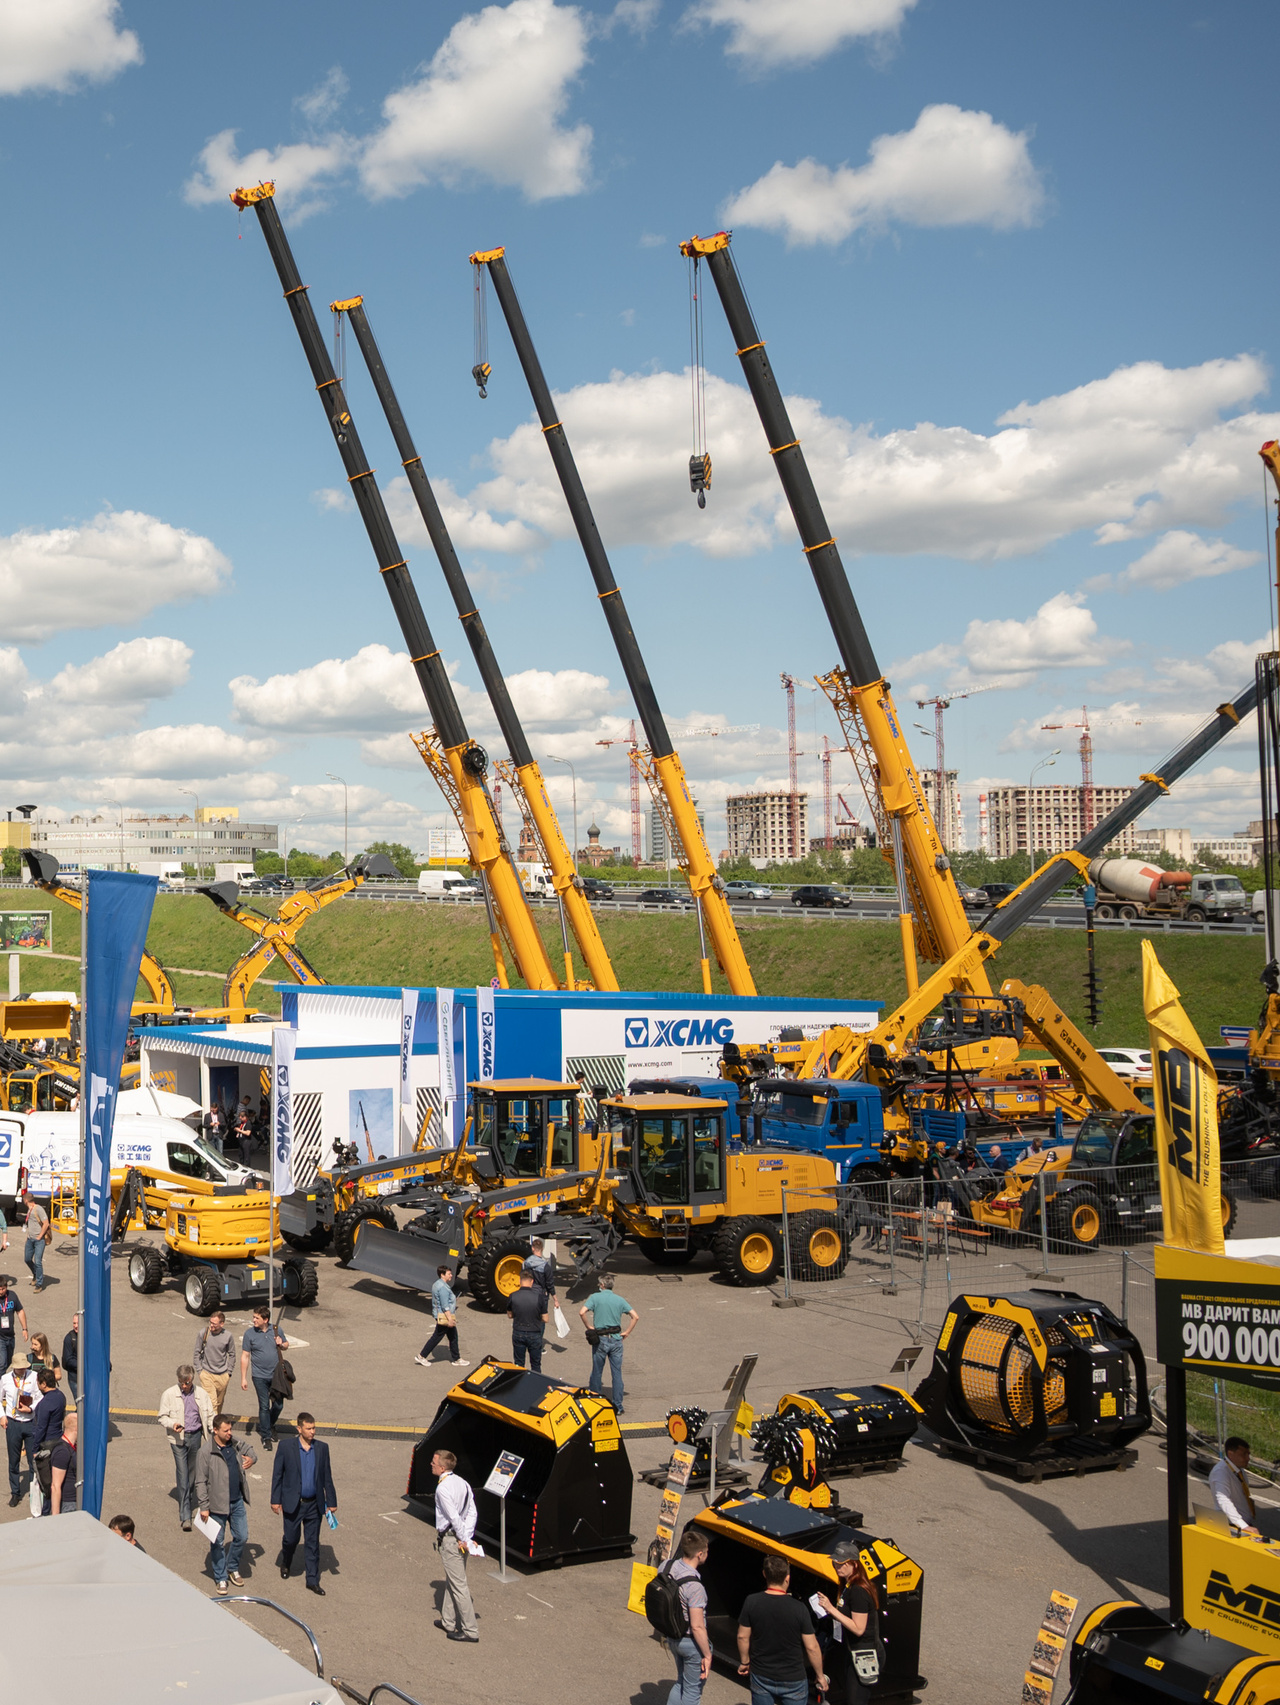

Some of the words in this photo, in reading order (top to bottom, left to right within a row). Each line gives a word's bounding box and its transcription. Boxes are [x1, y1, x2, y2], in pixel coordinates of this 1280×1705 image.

[649, 1017, 735, 1048] XCMG
[482, 1026, 493, 1077] XCMG
[780, 1044, 801, 1053] XCMG
[627, 1059, 673, 1069] www.xcmg.com
[277, 1085, 291, 1164] XCMG
[1158, 1046, 1194, 1185] MB
[126, 1144, 152, 1152] XCMG
[373, 1171, 395, 1181] XCMG
[503, 1197, 528, 1210] XCMG
[1204, 1304, 1250, 1323] ДАРИТ
[1252, 1307, 1280, 1325] ВАМ
[1182, 1321, 1231, 1362] 900
[1235, 1325, 1280, 1367] 000
[596, 1419, 613, 1428] MB
[1200, 1604, 1215, 1615] THE
[1217, 1612, 1259, 1632] CRUSHING
